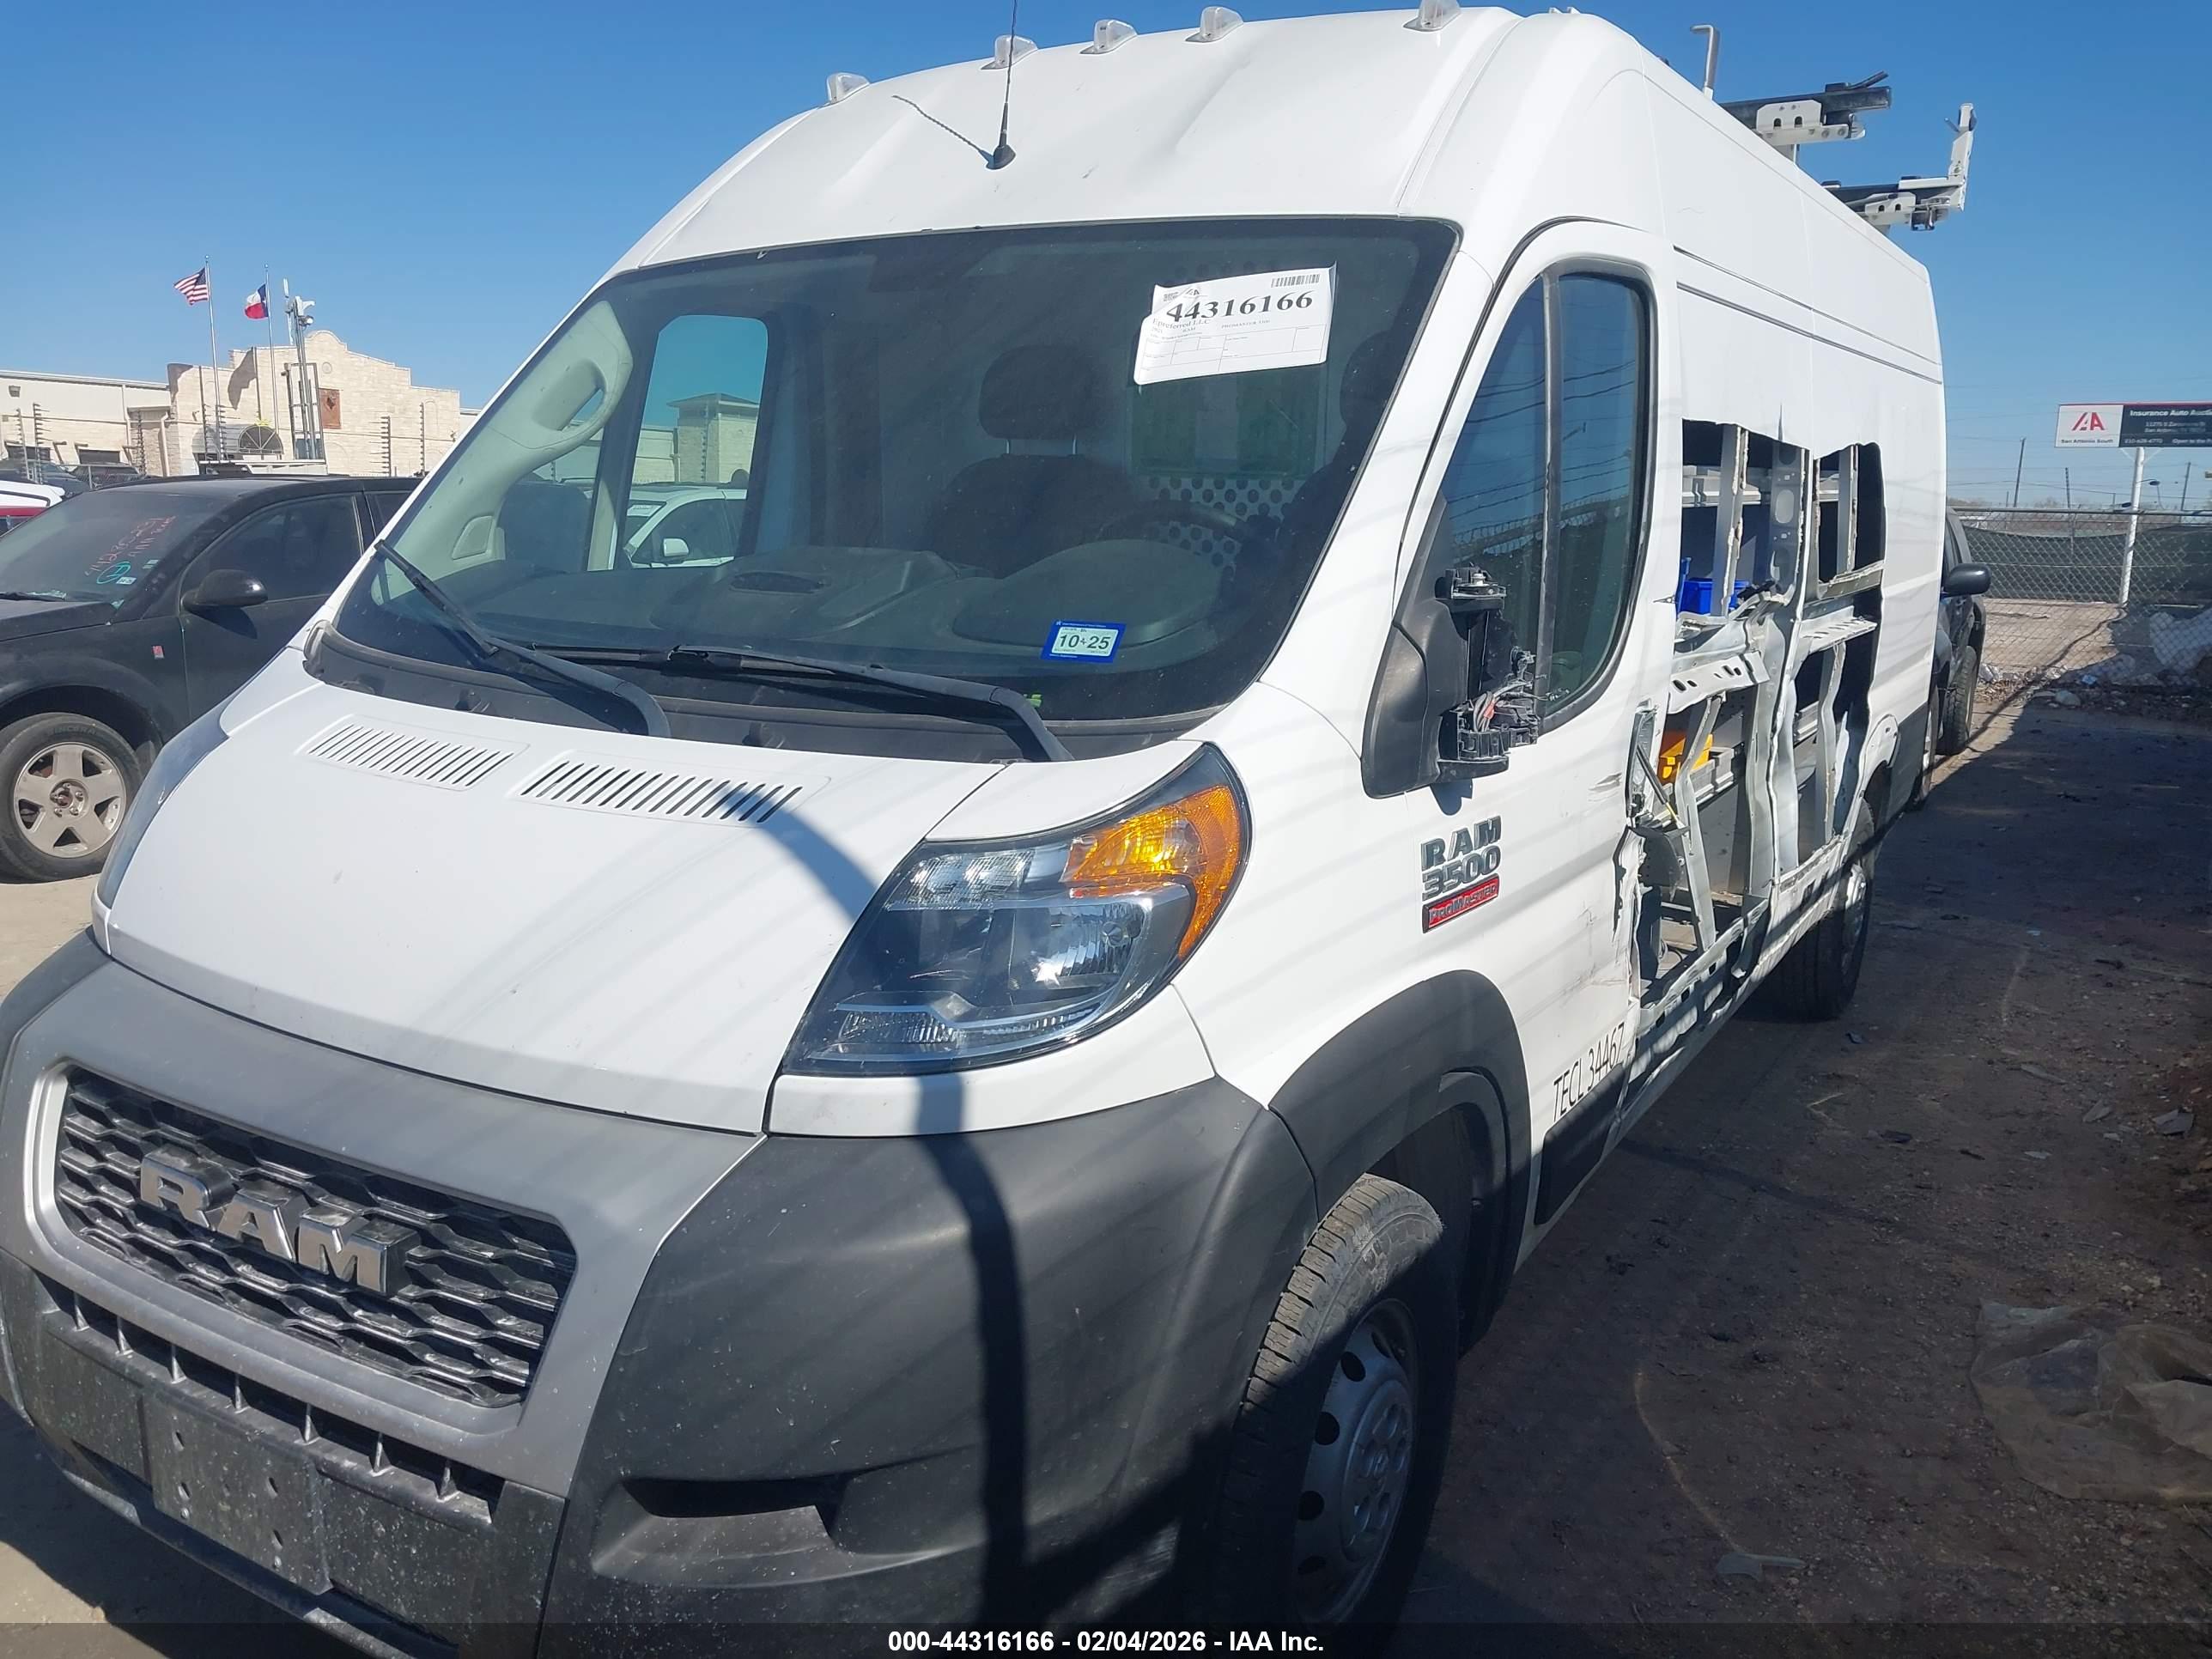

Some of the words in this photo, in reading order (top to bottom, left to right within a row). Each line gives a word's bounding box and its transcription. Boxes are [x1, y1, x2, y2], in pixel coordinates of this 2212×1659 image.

[1166, 290, 1314, 322] 44316166
[1421, 816, 1501, 871] RAM
[1422, 846, 1501, 901] 3500
[1553, 1057, 1584, 1122] TECL
[1588, 1022, 1625, 1091] 34467
[140, 1149, 410, 1293] RAM
